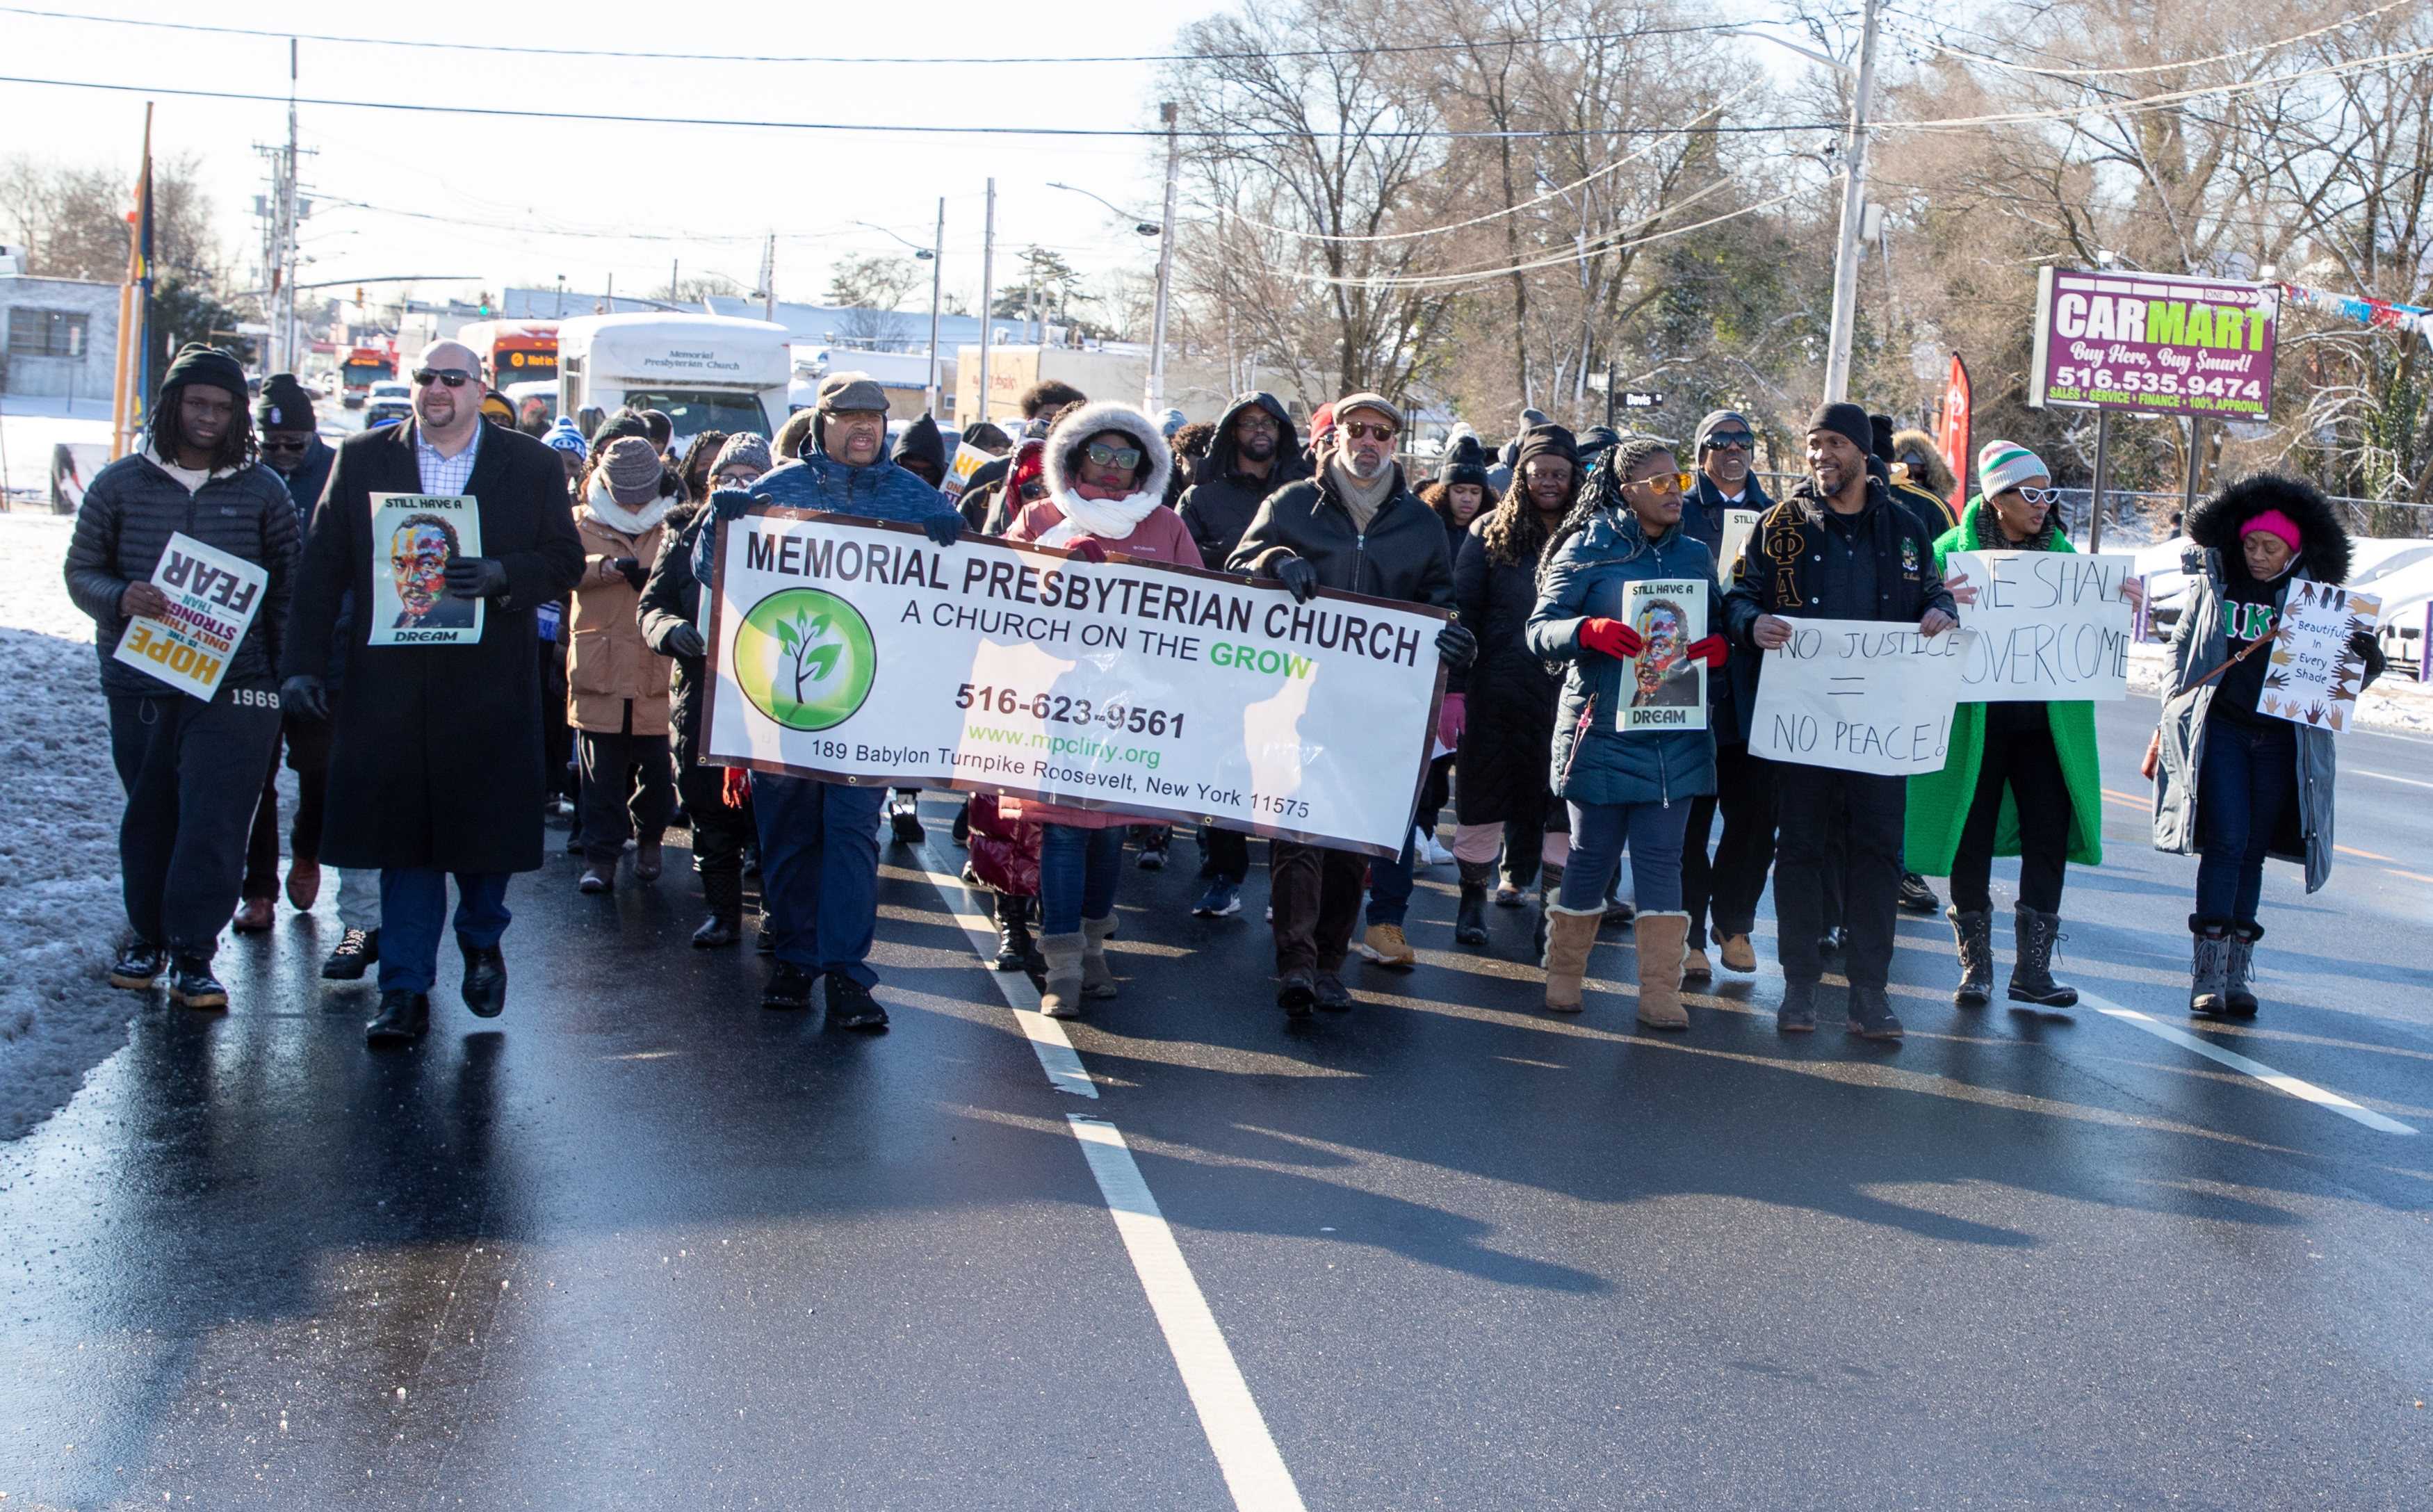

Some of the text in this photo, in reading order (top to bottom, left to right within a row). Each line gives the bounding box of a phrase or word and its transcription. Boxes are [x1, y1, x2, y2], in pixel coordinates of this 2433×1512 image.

[2207, 291, 2224, 299] ONE
[644, 358, 740, 370] Presbyterian Church
[669, 350, 714, 359] Memorial
[2069, 341, 2253, 375] Buy Here, Buy $mart!
[2056, 366, 2261, 400] 516.535.9474
[1627, 393, 1651, 405] Davis
[2049, 387, 2265, 414] SALES SERVICE FINANCE 100% APPROVAL
[953, 453, 986, 477] HO
[385, 498, 462, 509] STILL HAVE A
[1734, 514, 1754, 523] STILL
[163, 550, 258, 615] FEAR
[1632, 585, 1693, 595] STILL HAVE A
[1954, 556, 2133, 612] WE SHALL
[181, 594, 213, 615] THAN
[747, 530, 1421, 667] MEMORIAL PRESBYTERIAN CHURCH
[167, 601, 237, 640] STRONG
[2298, 621, 2346, 638] Beautiful
[154, 615, 231, 653] ONLY THI
[167, 629, 198, 648] IS THE
[394, 631, 458, 642] DREAM
[900, 600, 1312, 680] A CHURCH ON THE GROW
[1779, 628, 1963, 659] NO JUSTICE
[2313, 639, 2321, 649] In
[127, 626, 222, 686] HOPE
[1961, 623, 2130, 685] OVERCOME
[2300, 653, 2327, 671] Every
[2295, 668, 2327, 684] Shade
[232, 688, 280, 709] 1969
[955, 683, 1185, 738] 516-623-9561
[1633, 710, 1686, 724] DREAM
[968, 725, 1161, 770] www.mpcliny.org
[1773, 714, 1946, 762] NO PEACE!
[812, 740, 1309, 819] 189 Babylon Turnpike Roosevelt, New York 11575
